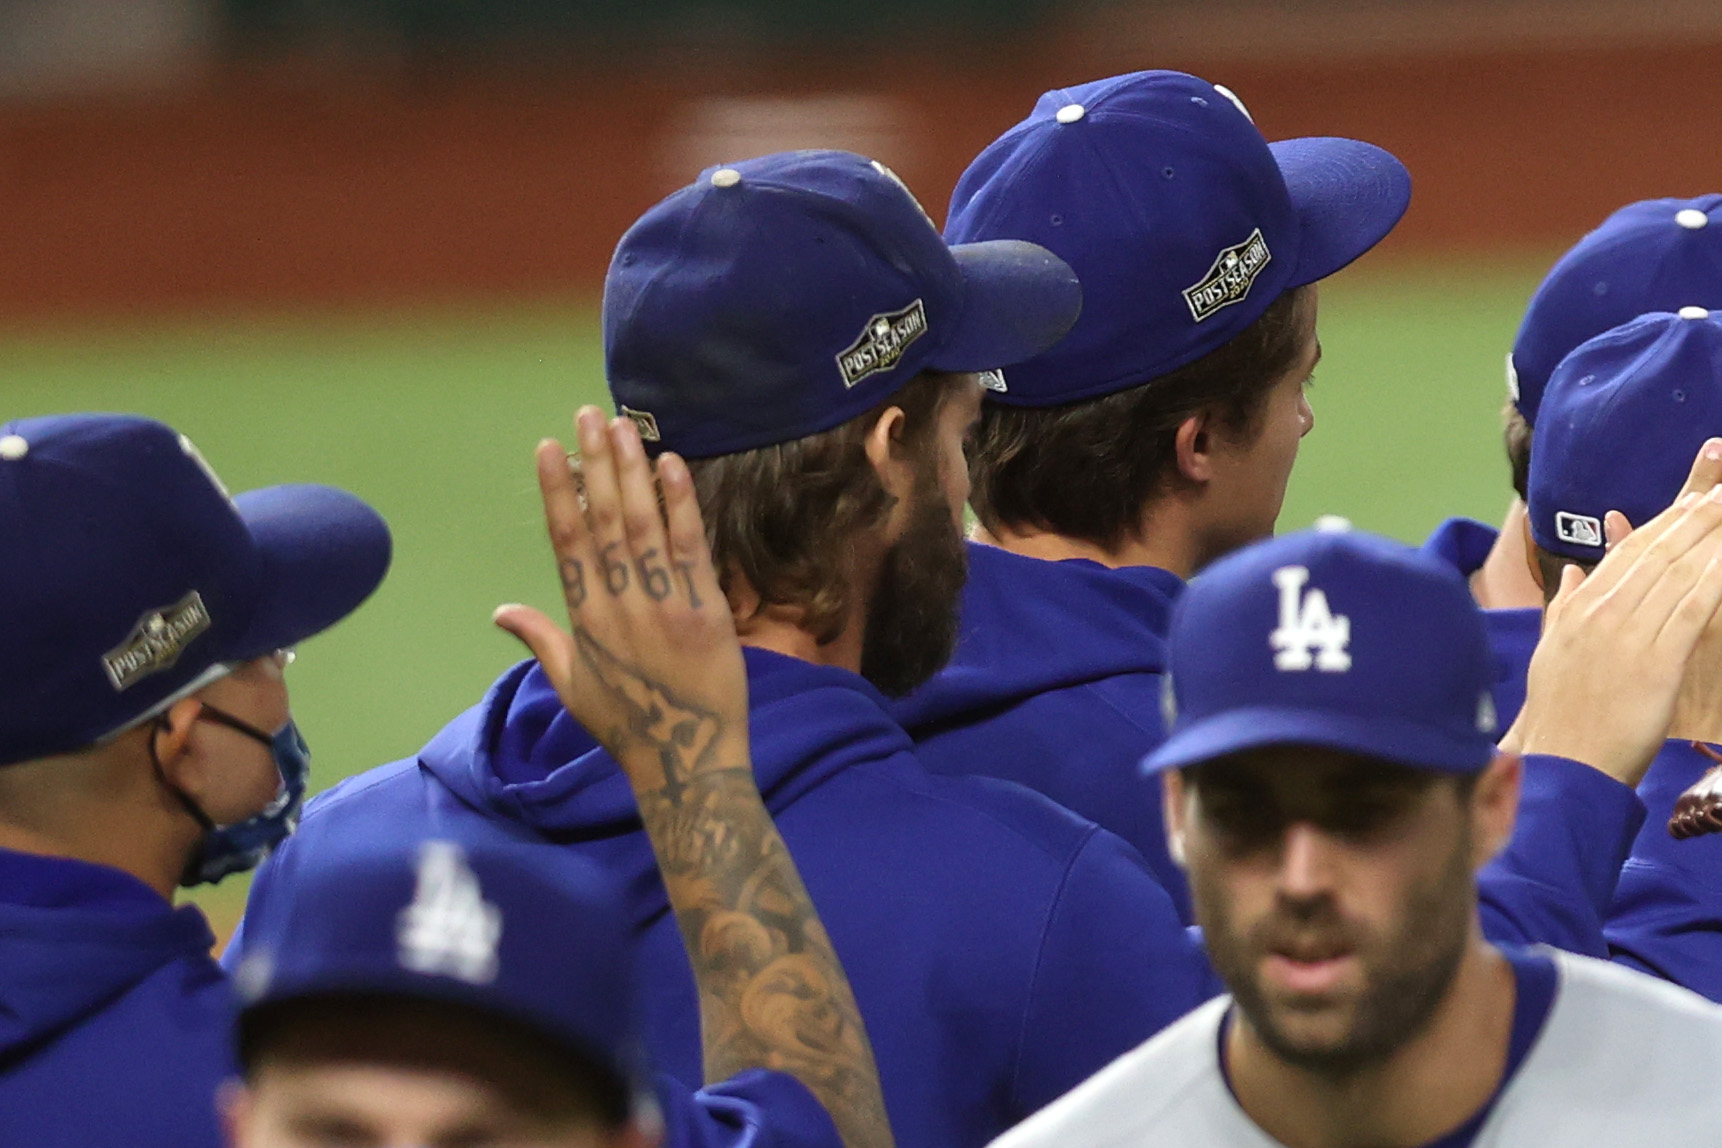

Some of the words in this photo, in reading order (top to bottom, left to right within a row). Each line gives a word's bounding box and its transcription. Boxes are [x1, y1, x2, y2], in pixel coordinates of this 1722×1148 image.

[1192, 240, 1265, 312] POSTSEASON
[843, 309, 922, 377] POSTSEASON
[1268, 565, 1352, 672] LA
